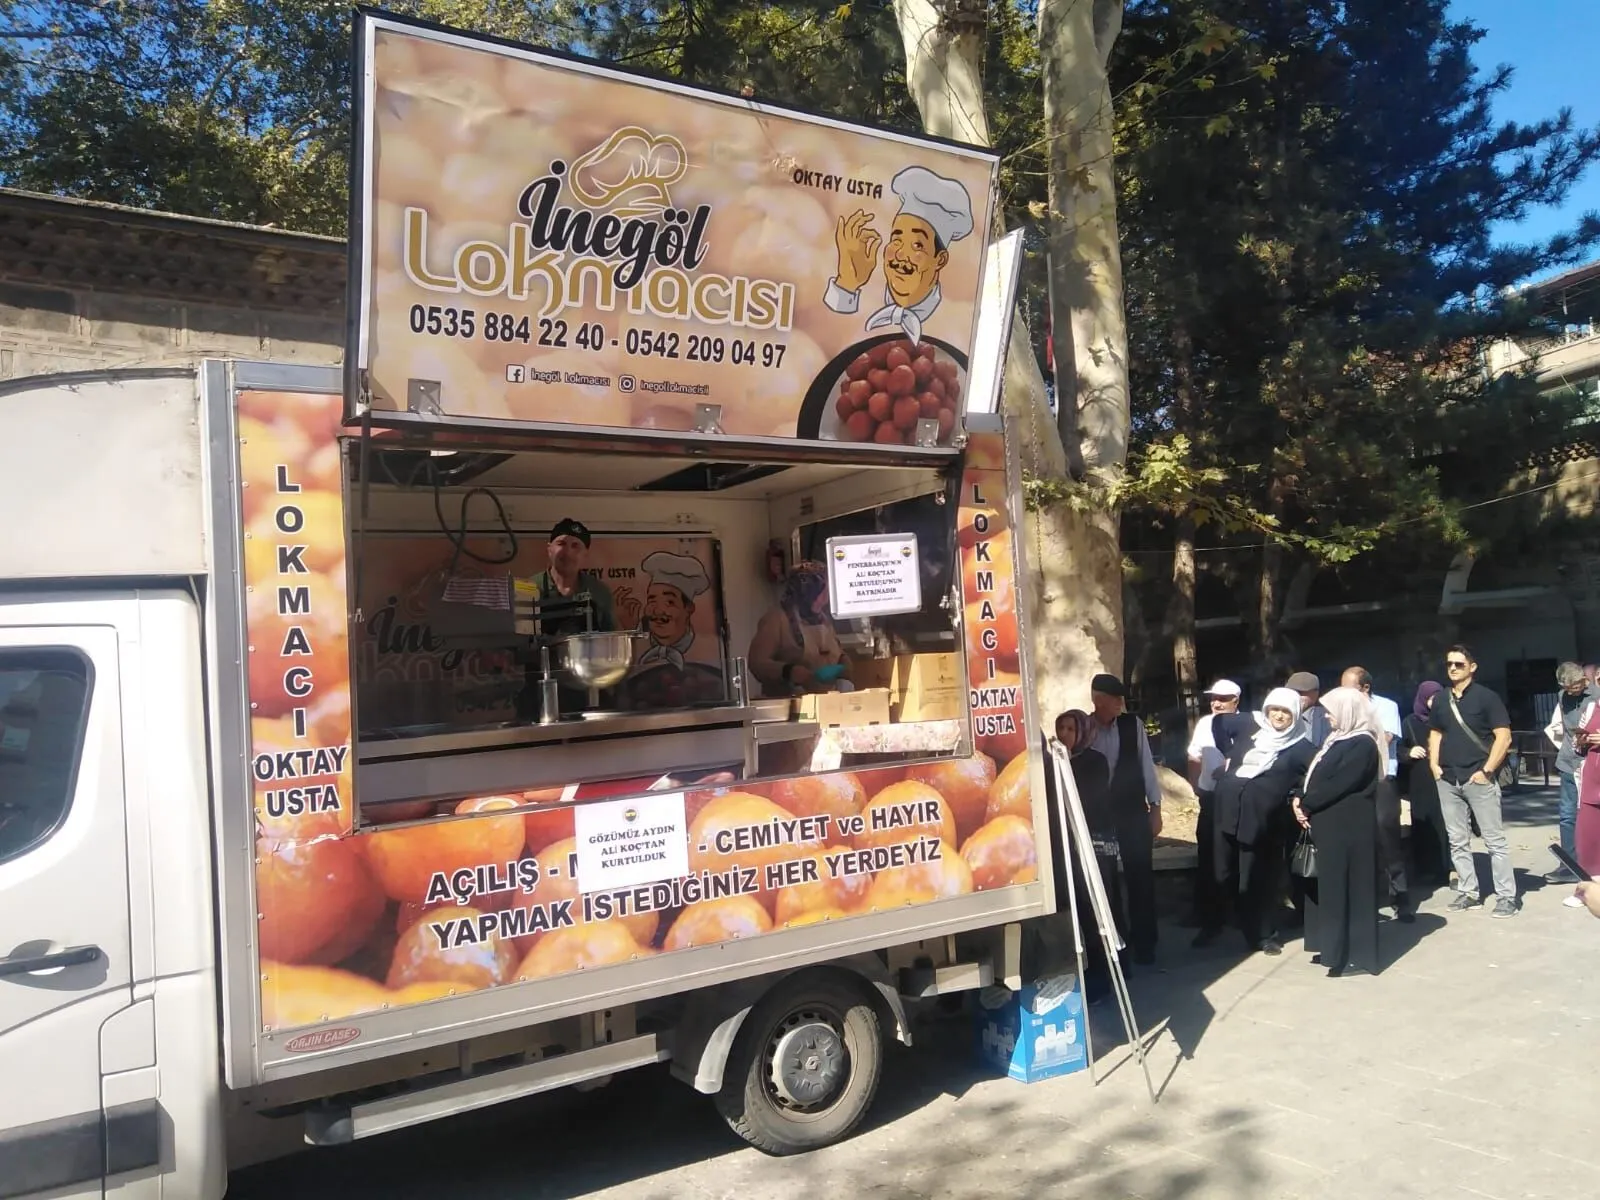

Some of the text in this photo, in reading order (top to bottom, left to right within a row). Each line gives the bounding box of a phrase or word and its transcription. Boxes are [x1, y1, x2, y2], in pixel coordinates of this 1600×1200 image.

[793, 168, 882, 199] OKTAY USTA
[518, 159, 711, 290] İnegöl
[409, 304, 475, 338] 0535
[484, 312, 530, 344] 884
[538, 318, 568, 348] 22
[575, 322, 604, 351] 40
[625, 328, 679, 358] 0542
[686, 334, 724, 362] 209
[731, 339, 756, 366] 04
[762, 343, 787, 369] 97
[608, 567, 636, 579] USTA
[973, 484, 998, 679] LOKMACI
[275, 464, 312, 737] LOKMACI
[970, 687, 1016, 709] OKTAY
[975, 714, 1015, 736] USTA
[255, 747, 348, 780] OKTAY
[266, 784, 340, 817] USTA
[588, 824, 676, 844] GÖZÜMÜZ AYDIN
[715, 814, 830, 855] CEMİYET
[837, 815, 865, 837] ve
[871, 800, 941, 832] HAYIR
[601, 838, 666, 856] ALİ KOÇ'TAN
[601, 851, 667, 869] KURTULDUK
[426, 859, 539, 904] AÇILIŞ
[431, 900, 575, 951] YAPMAK
[583, 864, 759, 923] İSTEDİĞİNİZ
[766, 858, 819, 890] HER
[825, 836, 943, 878] YERDEYİZ
[324, 1028, 352, 1043] CASE
